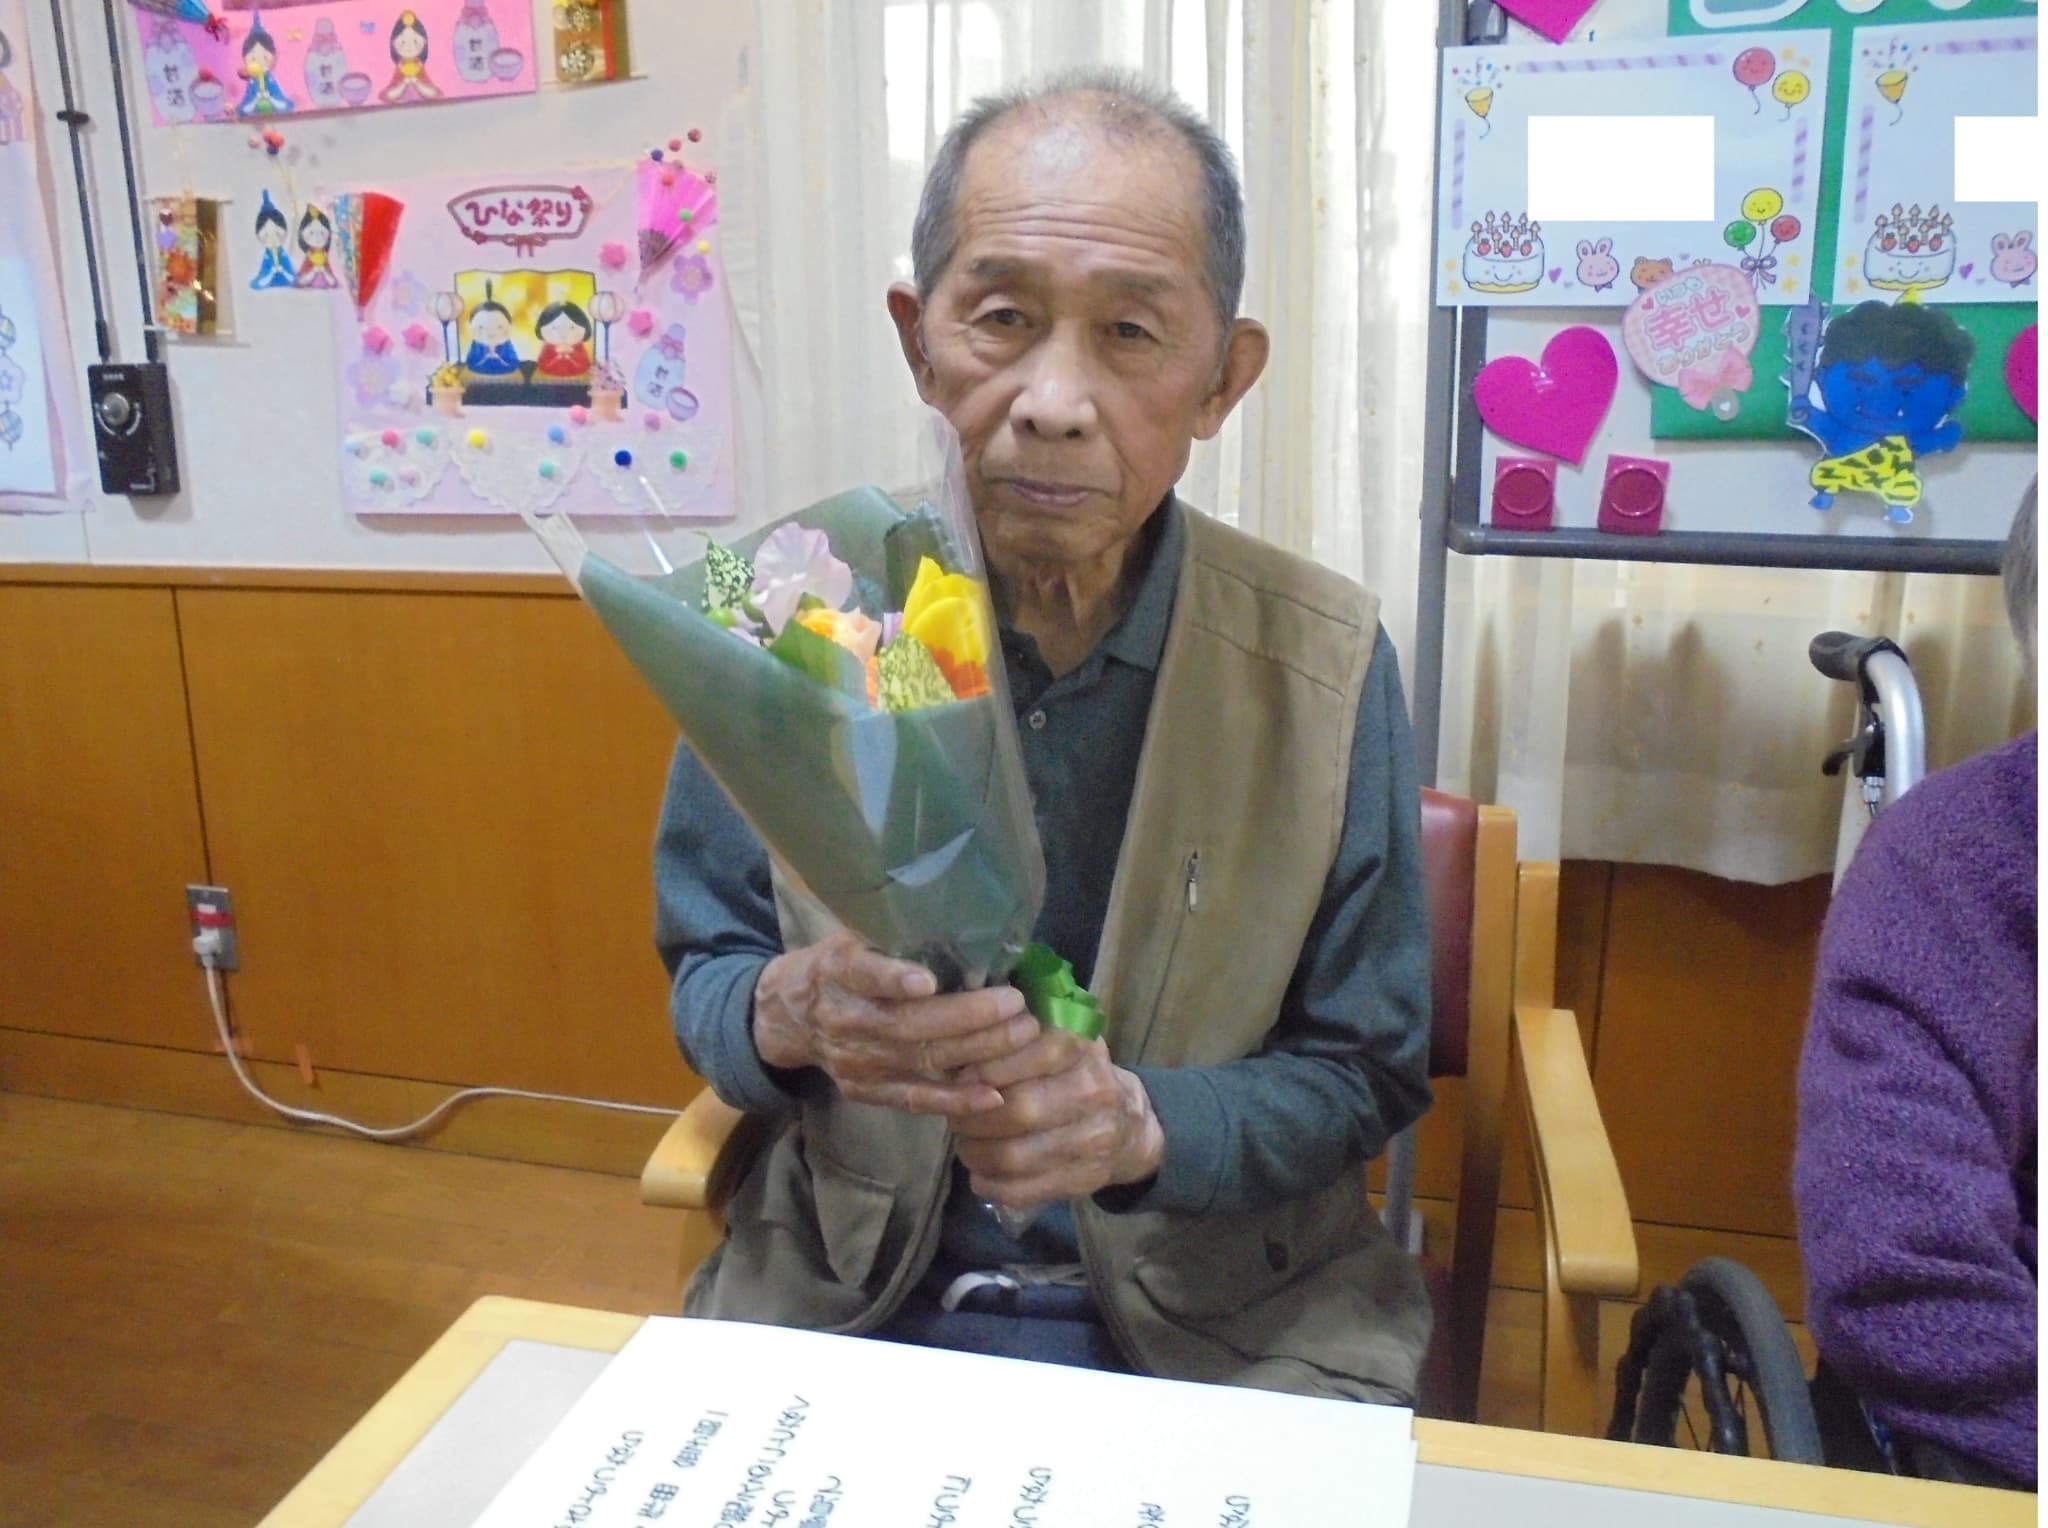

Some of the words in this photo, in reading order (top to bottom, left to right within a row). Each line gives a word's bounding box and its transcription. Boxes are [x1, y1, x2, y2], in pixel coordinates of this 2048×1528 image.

[465, 198, 572, 227] ひな祭り
[1645, 287, 1733, 349] 幸せ
[554, 1431, 643, 1528] さようなら
[1009, 1467, 1051, 1528] うなら
